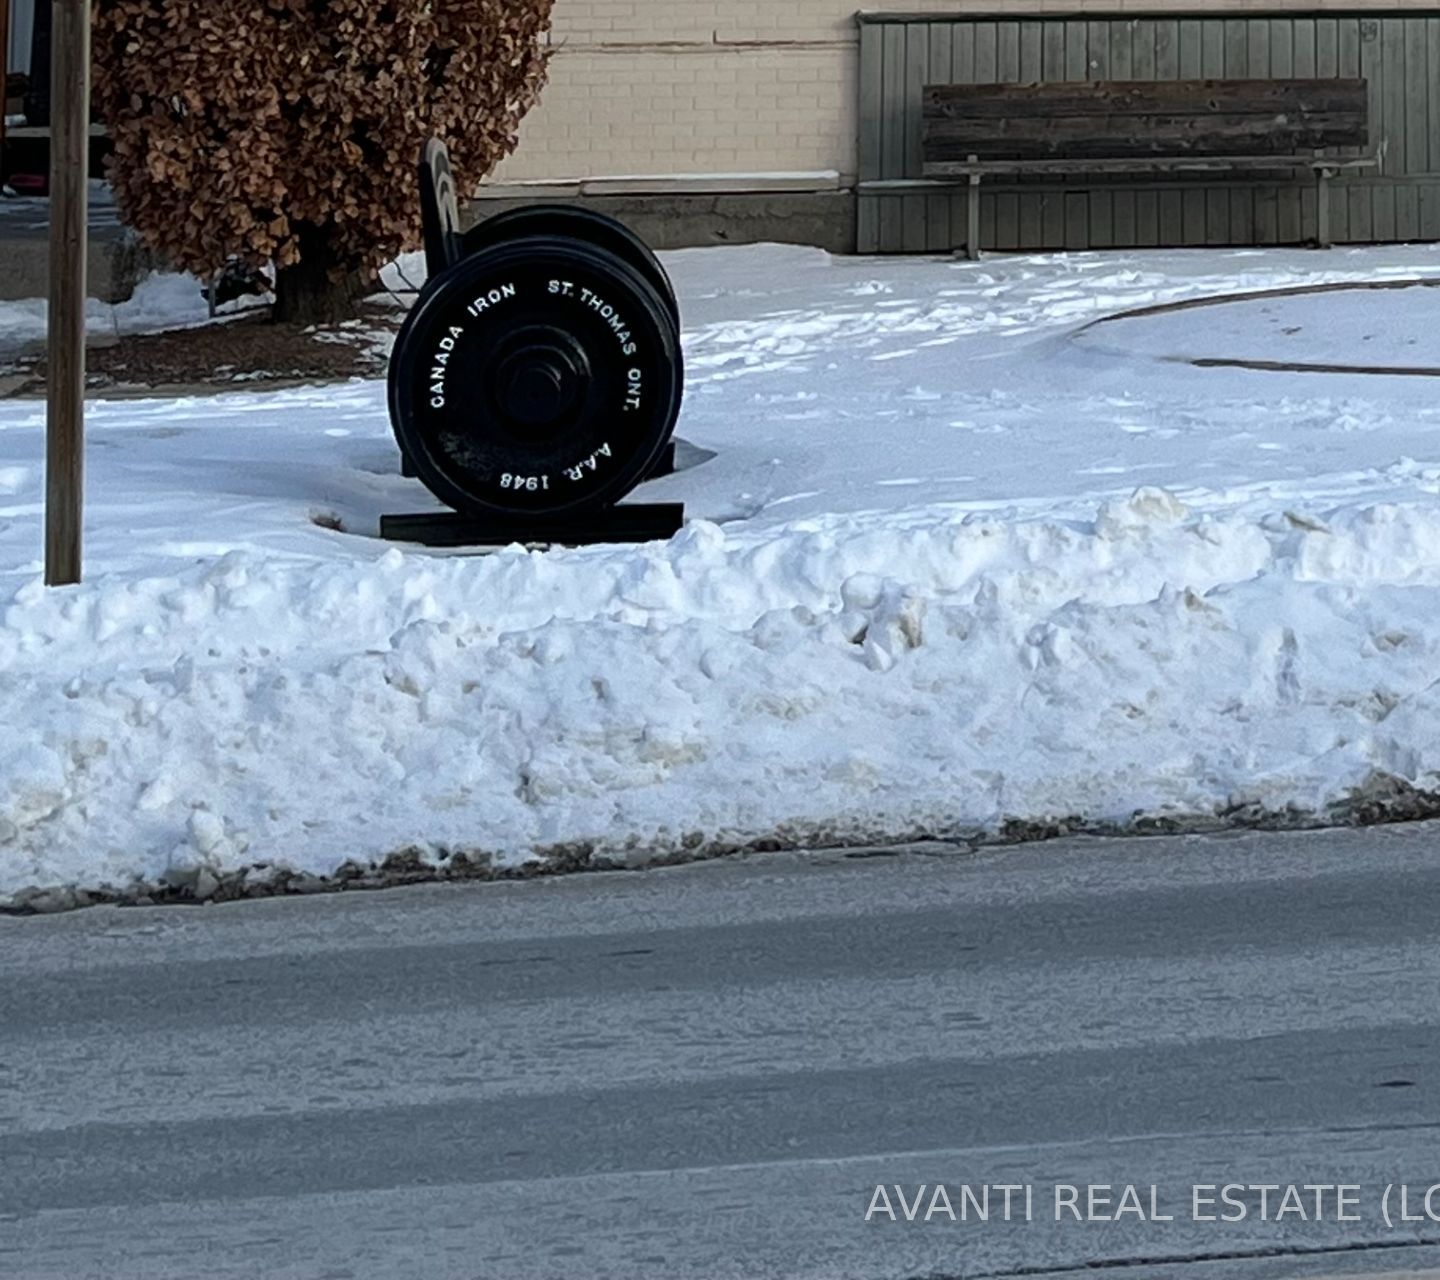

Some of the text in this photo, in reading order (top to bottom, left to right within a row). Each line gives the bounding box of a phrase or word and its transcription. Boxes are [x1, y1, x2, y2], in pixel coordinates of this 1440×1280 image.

[430, 283, 517, 409] CANADA IRON
[548, 280, 642, 412] ST. THOMAS ONT.
[500, 472, 549, 490] 1948
